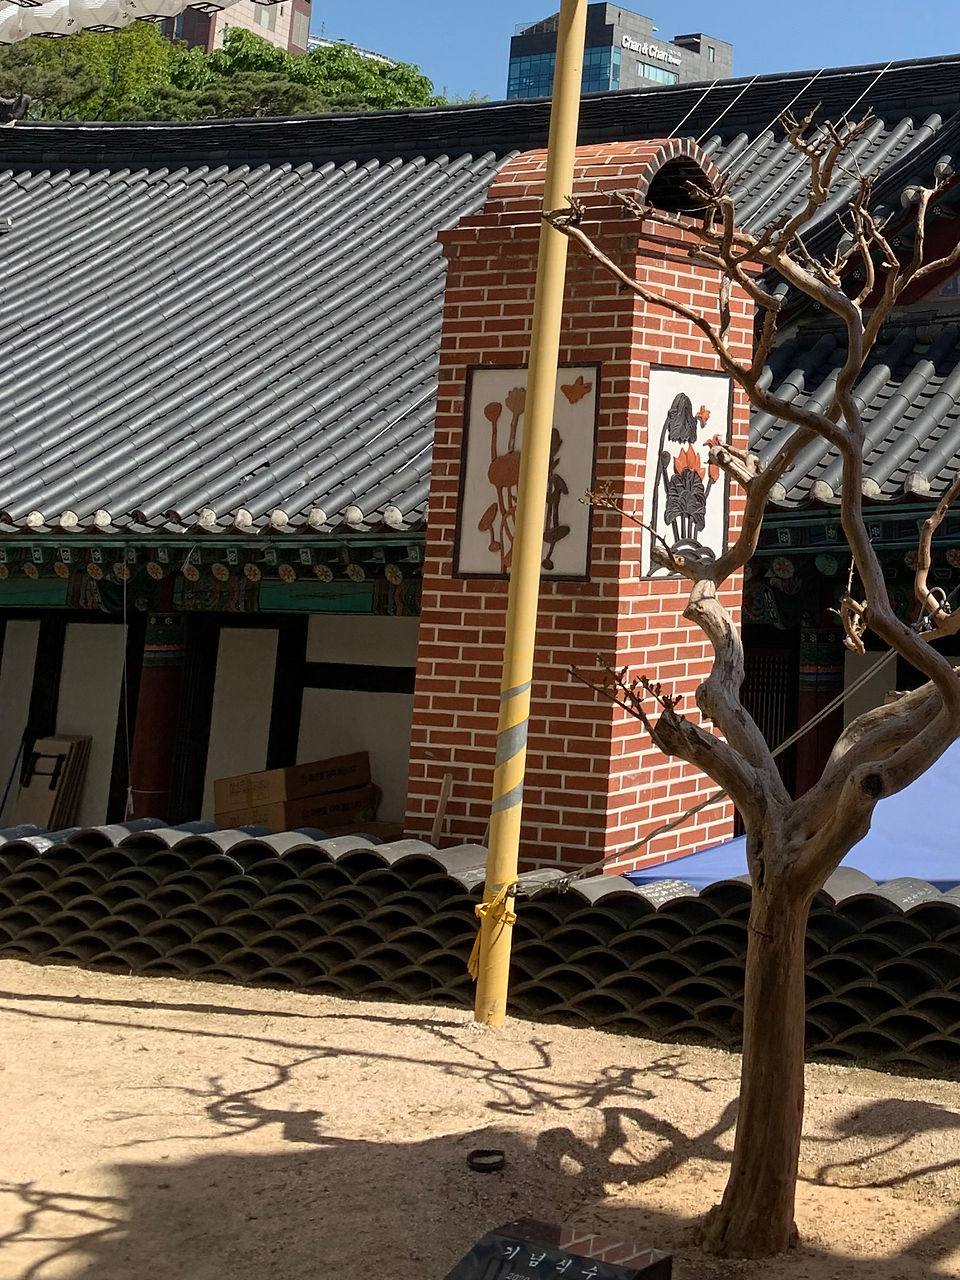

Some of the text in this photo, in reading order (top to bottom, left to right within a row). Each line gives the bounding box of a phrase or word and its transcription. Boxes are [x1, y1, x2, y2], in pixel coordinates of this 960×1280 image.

[621, 35, 641, 53] Chan
[641, 42, 649, 56] &
[648, 44, 668, 62] Chan
